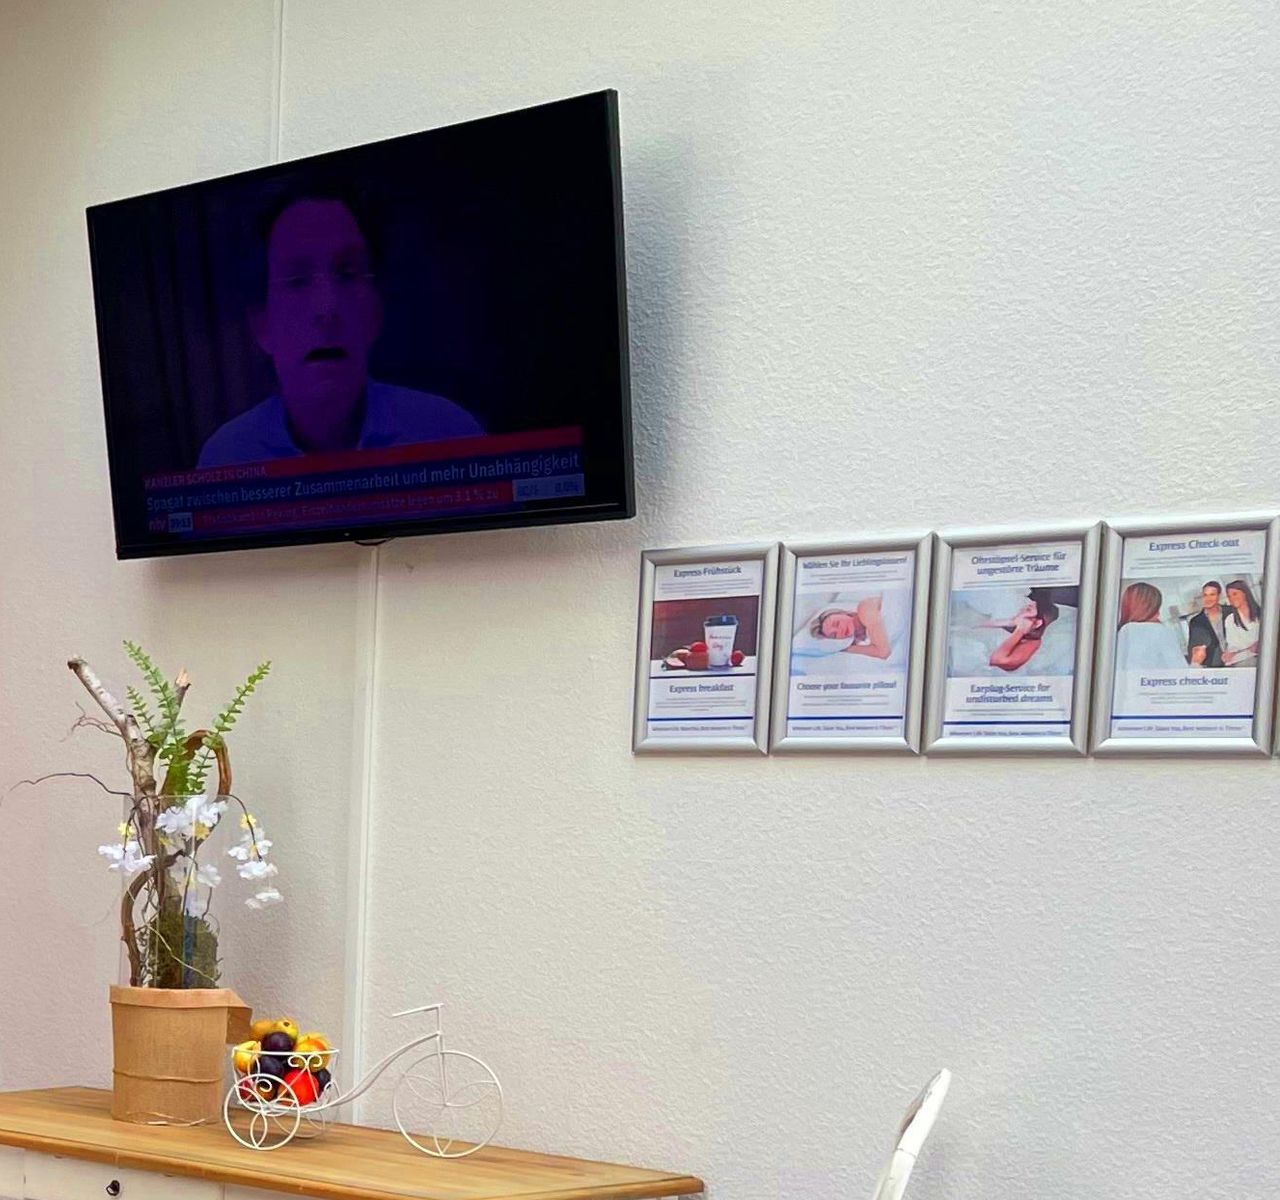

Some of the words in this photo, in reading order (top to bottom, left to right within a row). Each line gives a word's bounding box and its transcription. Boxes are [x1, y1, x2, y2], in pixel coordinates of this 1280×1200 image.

[146, 496, 183, 513] Spagat
[187, 489, 239, 507] zwischen
[241, 485, 292, 502] besserer
[294, 474, 399, 498] Zusammenarbeit
[401, 467, 428, 485] und
[430, 466, 465, 483] mehr
[468, 451, 580, 479] Unabhängigkeit
[1148, 541, 1186, 553] Express
[1188, 538, 1240, 550] Check-out
[1140, 676, 1177, 688] Express
[1179, 675, 1228, 687] check-out
